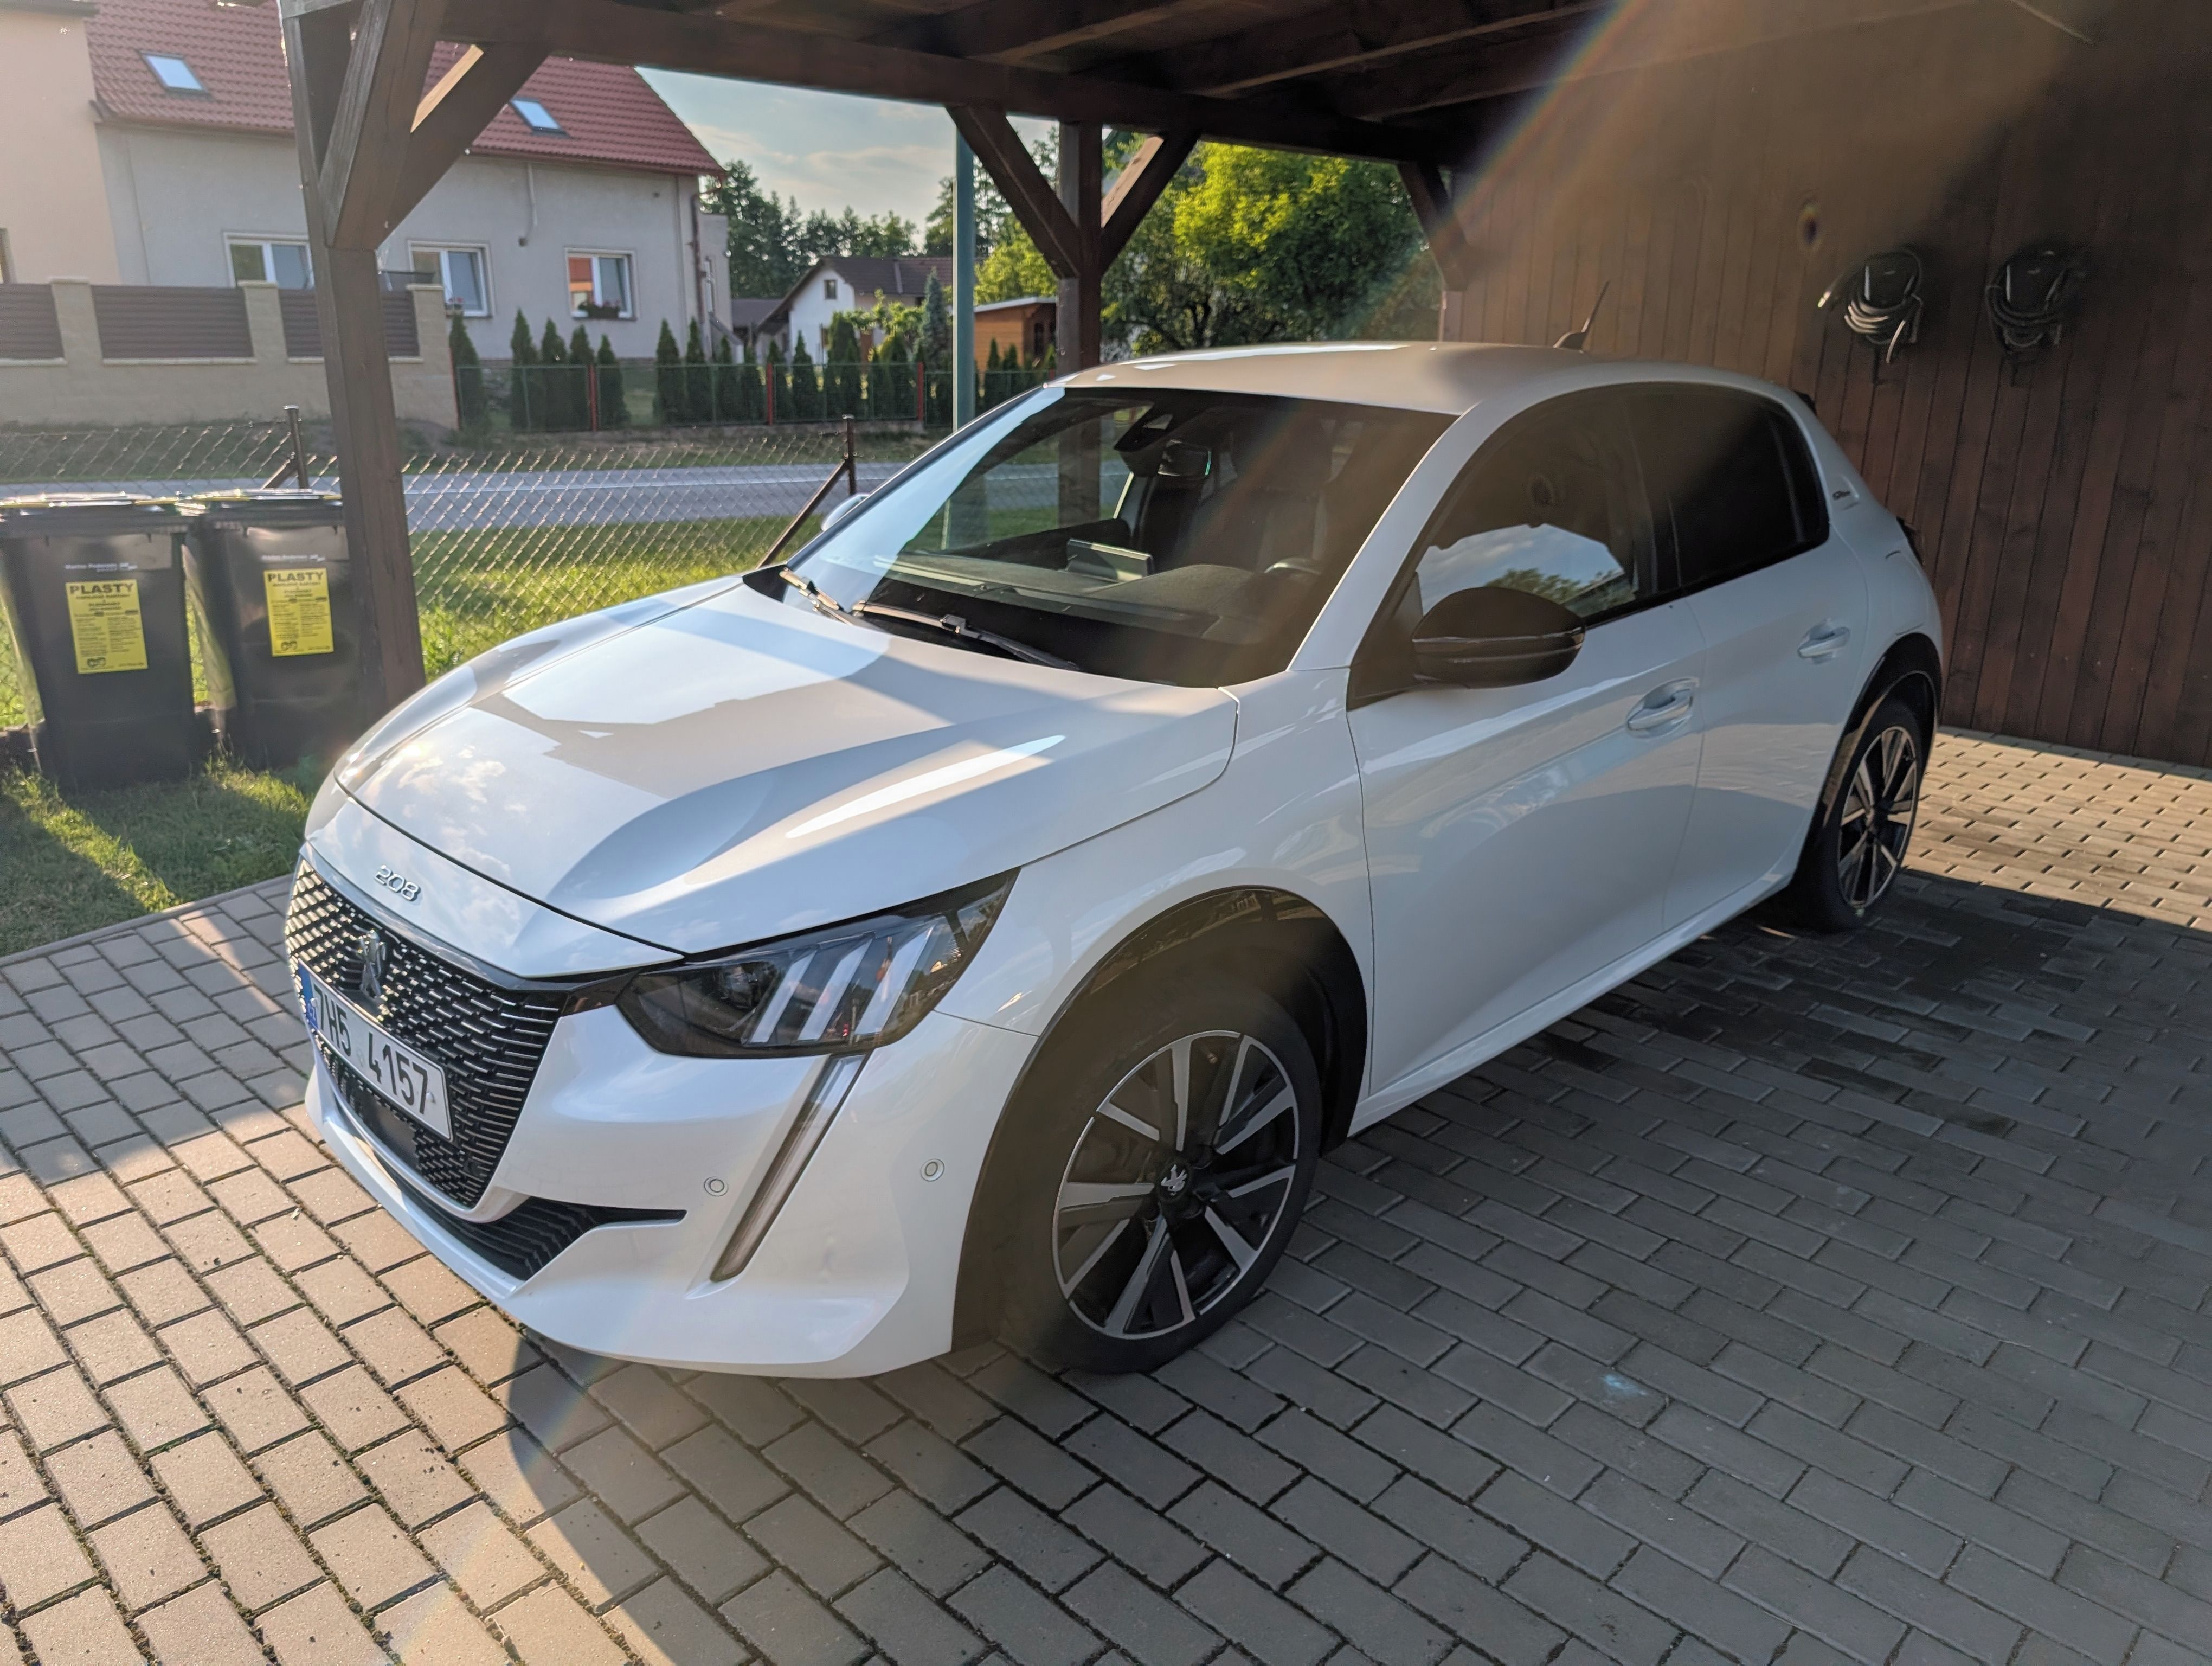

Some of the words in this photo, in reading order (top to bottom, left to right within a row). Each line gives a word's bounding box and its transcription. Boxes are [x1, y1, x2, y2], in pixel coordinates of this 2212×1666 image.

[70, 583, 134, 595] PLASTY
[268, 572, 323, 582] PLASTY
[374, 864, 420, 901] 208
[314, 983, 351, 1057] 7H5
[368, 1031, 428, 1115] 4157
